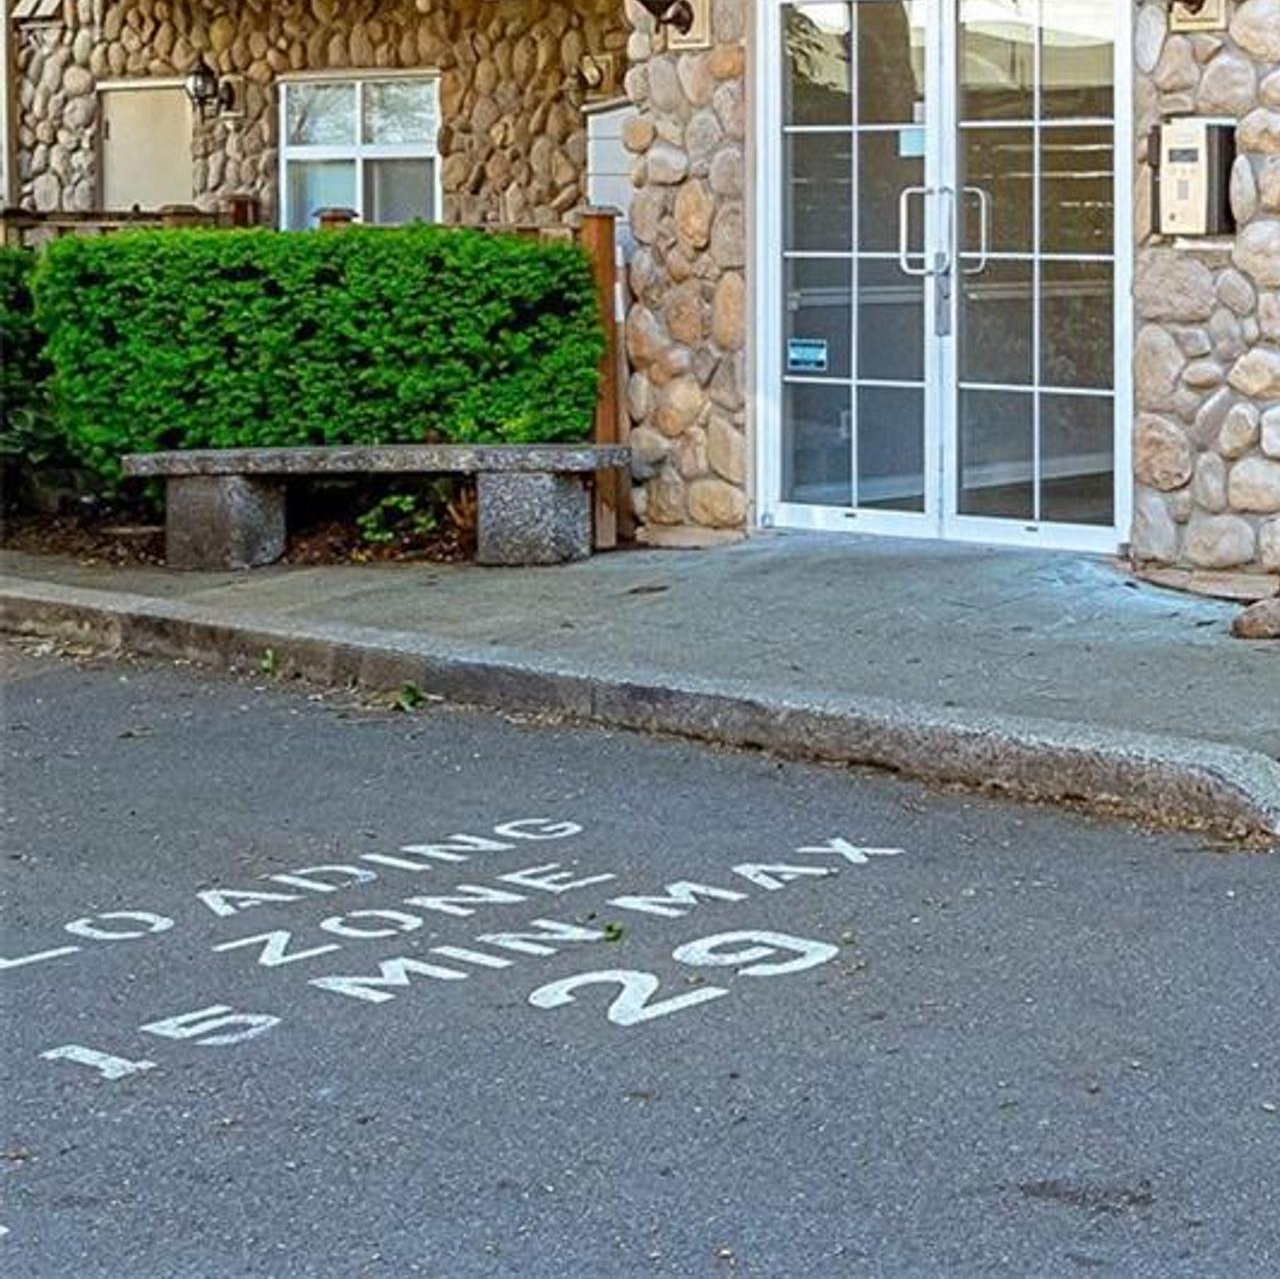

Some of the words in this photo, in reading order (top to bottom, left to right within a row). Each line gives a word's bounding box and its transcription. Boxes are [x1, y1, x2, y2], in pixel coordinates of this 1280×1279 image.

[40, 1004, 283, 1080] 15
[307, 920, 605, 1003] MIN
[606, 837, 905, 917] MAX
[212, 863, 616, 967] ZONE
[528, 930, 840, 1026] 29
